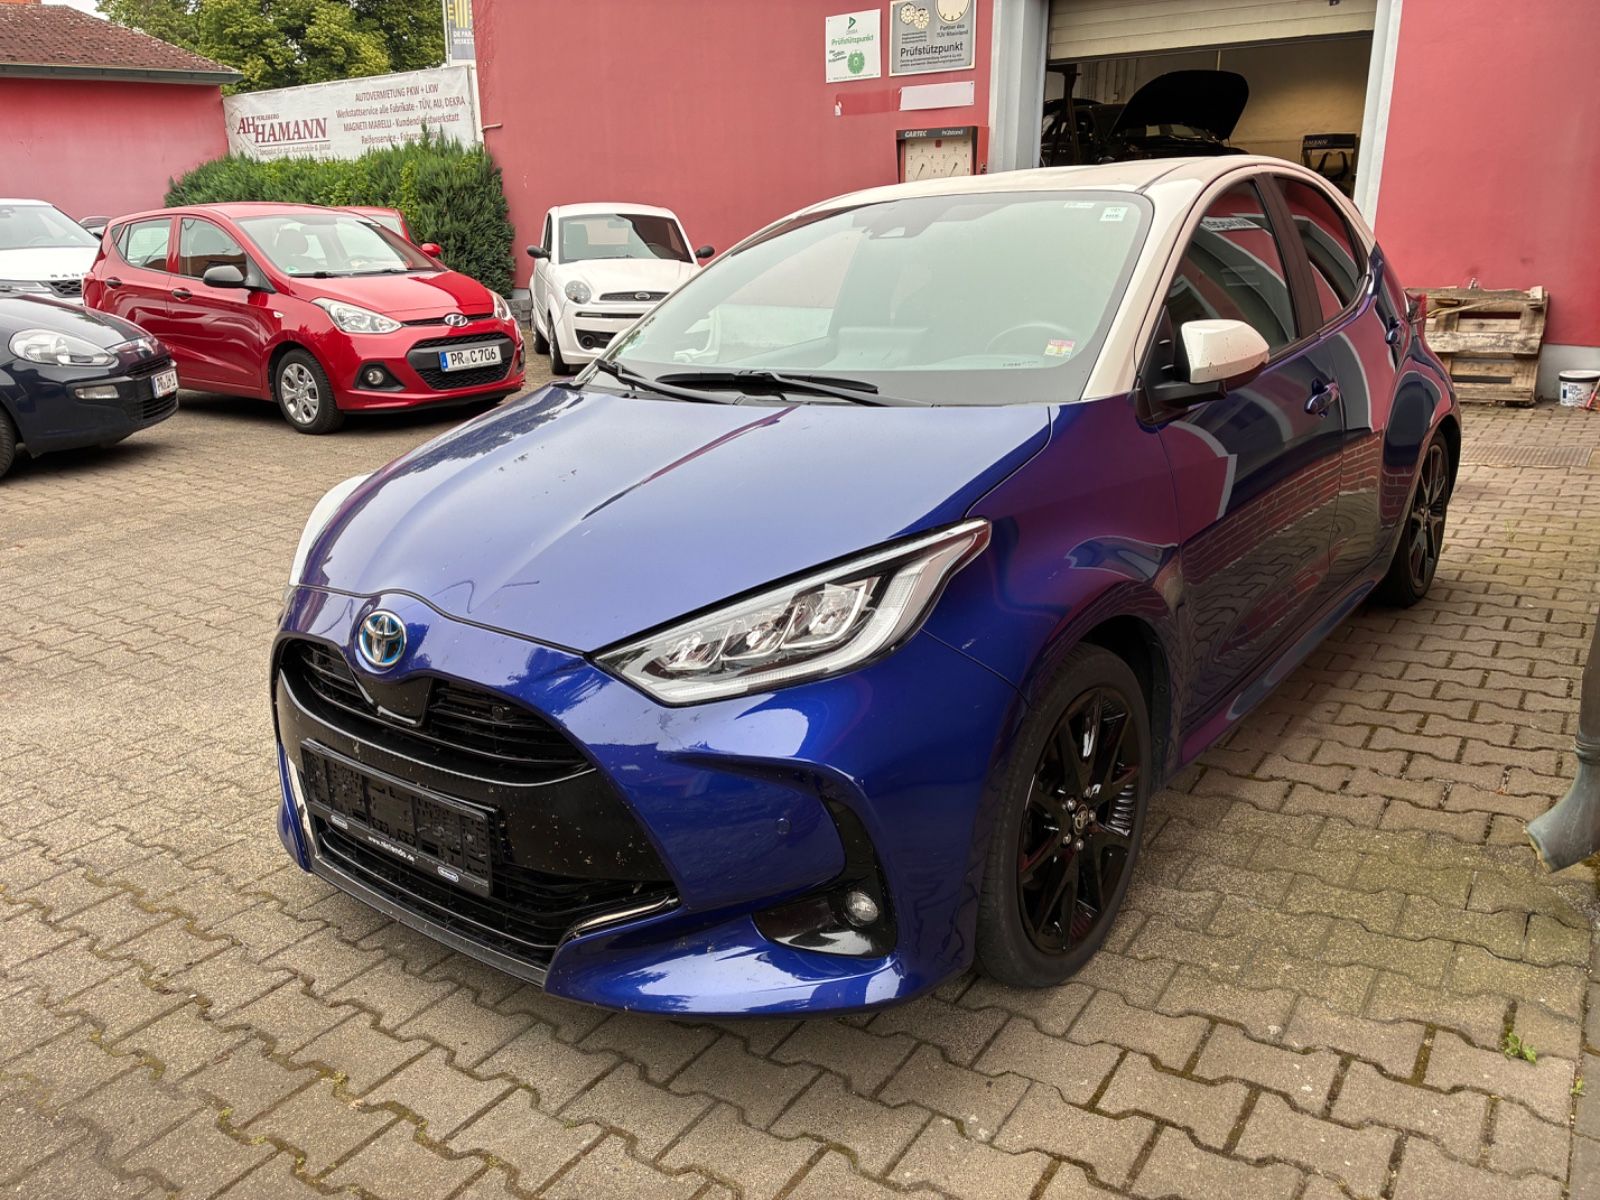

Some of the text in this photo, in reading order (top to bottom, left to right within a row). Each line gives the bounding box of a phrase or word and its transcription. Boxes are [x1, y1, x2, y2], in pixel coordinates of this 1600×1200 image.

[900, 41, 964, 57] Prüfstützpunkt
[355, 87, 405, 102] AUTOVERMIETUNG
[406, 86, 420, 97] PKW
[425, 83, 439, 94] LKW
[336, 105, 378, 118] Werkstattservice
[390, 102, 415, 113] Fabrikate
[445, 96, 466, 107] DEKRA
[236, 117, 256, 134] AH
[254, 117, 328, 143] HAMANN
[343, 121, 368, 132] MAGNETI
[368, 118, 392, 130] MARELLI
[904, 130, 928, 138] CARTEC
[451, 347, 496, 366] PR C 706
